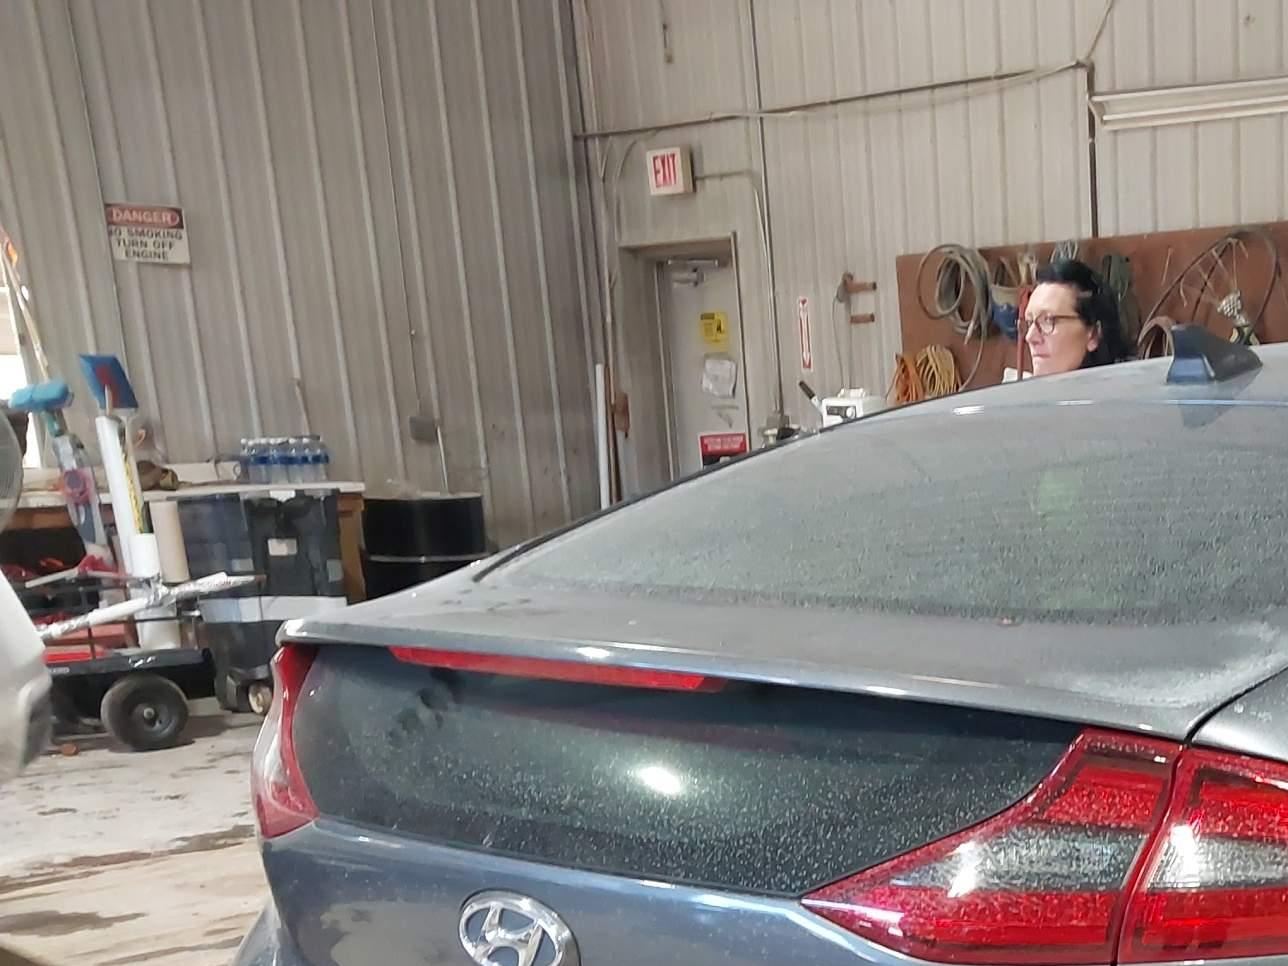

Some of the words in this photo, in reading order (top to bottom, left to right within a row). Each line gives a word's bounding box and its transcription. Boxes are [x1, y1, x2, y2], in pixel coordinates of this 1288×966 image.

[652, 153, 677, 188] EXIT
[111, 208, 173, 224] DANGER
[127, 229, 183, 240] SMOKING
[116, 238, 148, 248] TURN
[153, 240, 173, 250] OFF
[125, 249, 168, 260] ENGINE
